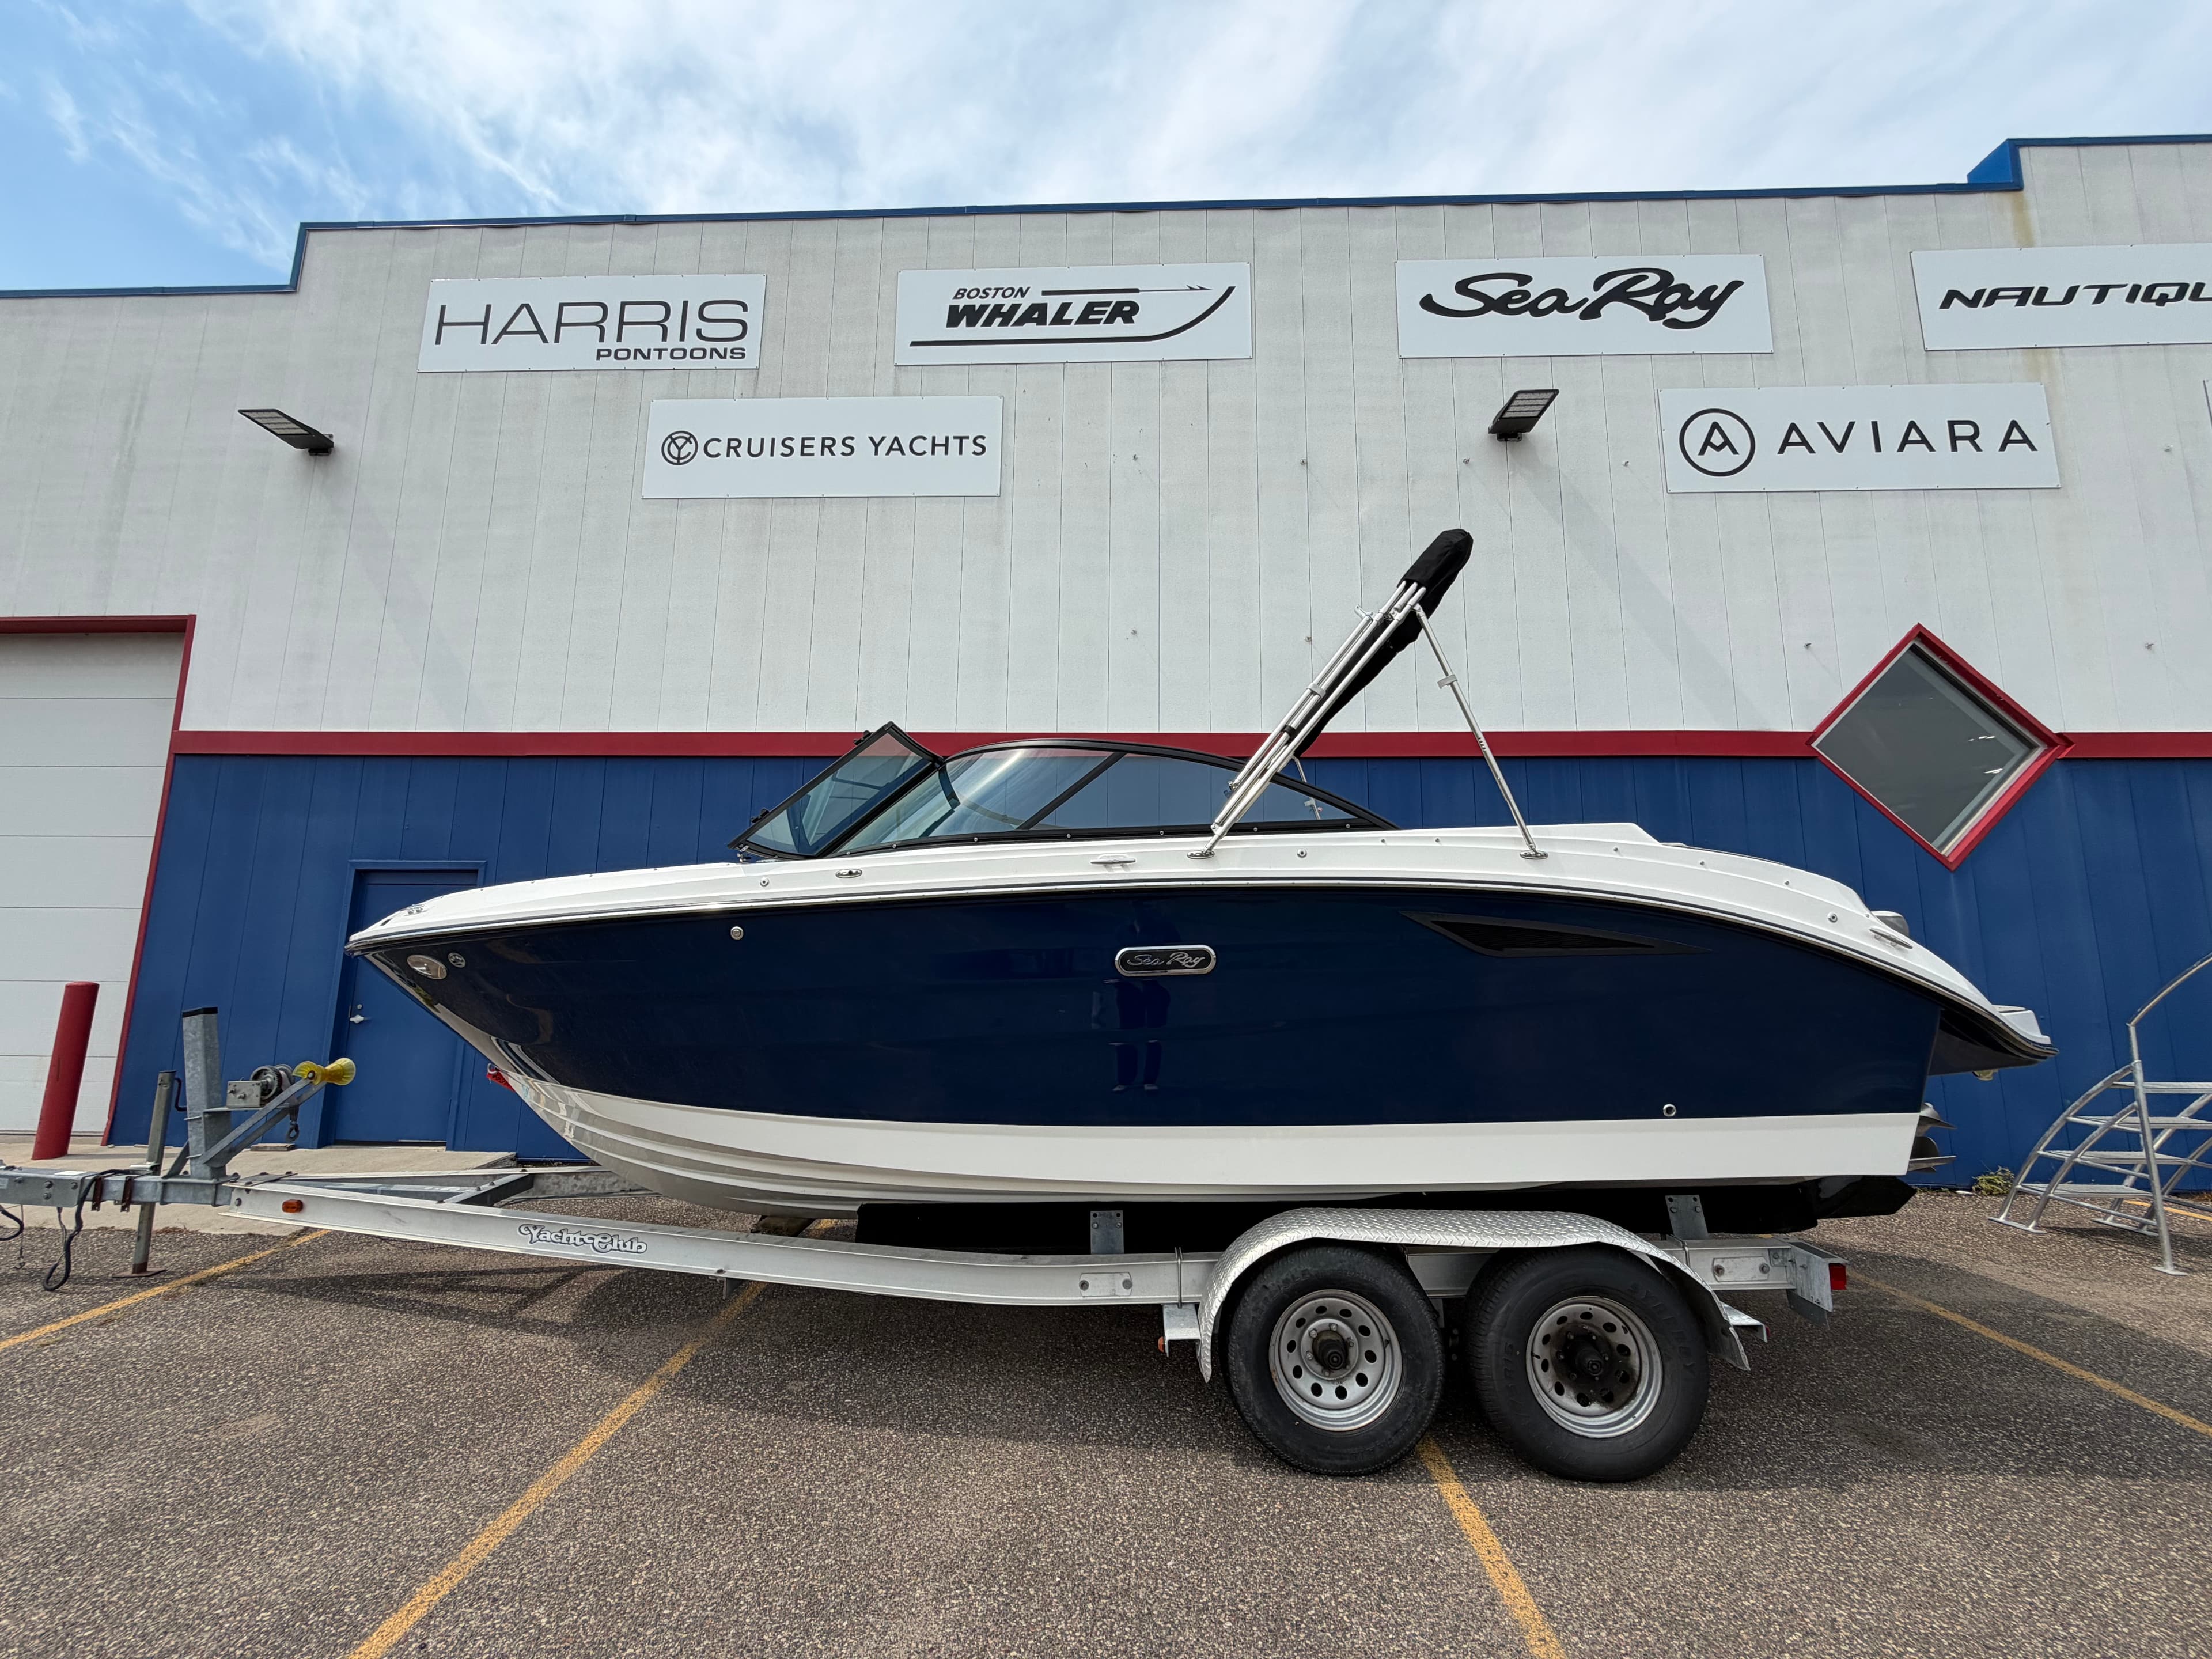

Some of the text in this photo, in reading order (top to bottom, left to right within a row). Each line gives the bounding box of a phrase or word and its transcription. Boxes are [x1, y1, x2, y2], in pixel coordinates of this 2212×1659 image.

[952, 286, 1031, 300] BOSTON
[1418, 267, 1745, 329] Sea Ray
[435, 300, 748, 345] HARRIS
[946, 300, 1139, 328] WHALER
[596, 347, 745, 361] PONTOONS
[703, 436, 855, 458] CRUISERS
[868, 435, 986, 456] YACHTS
[1777, 419, 2038, 454] AVIARA
[1127, 952, 1205, 968] Sea Ray
